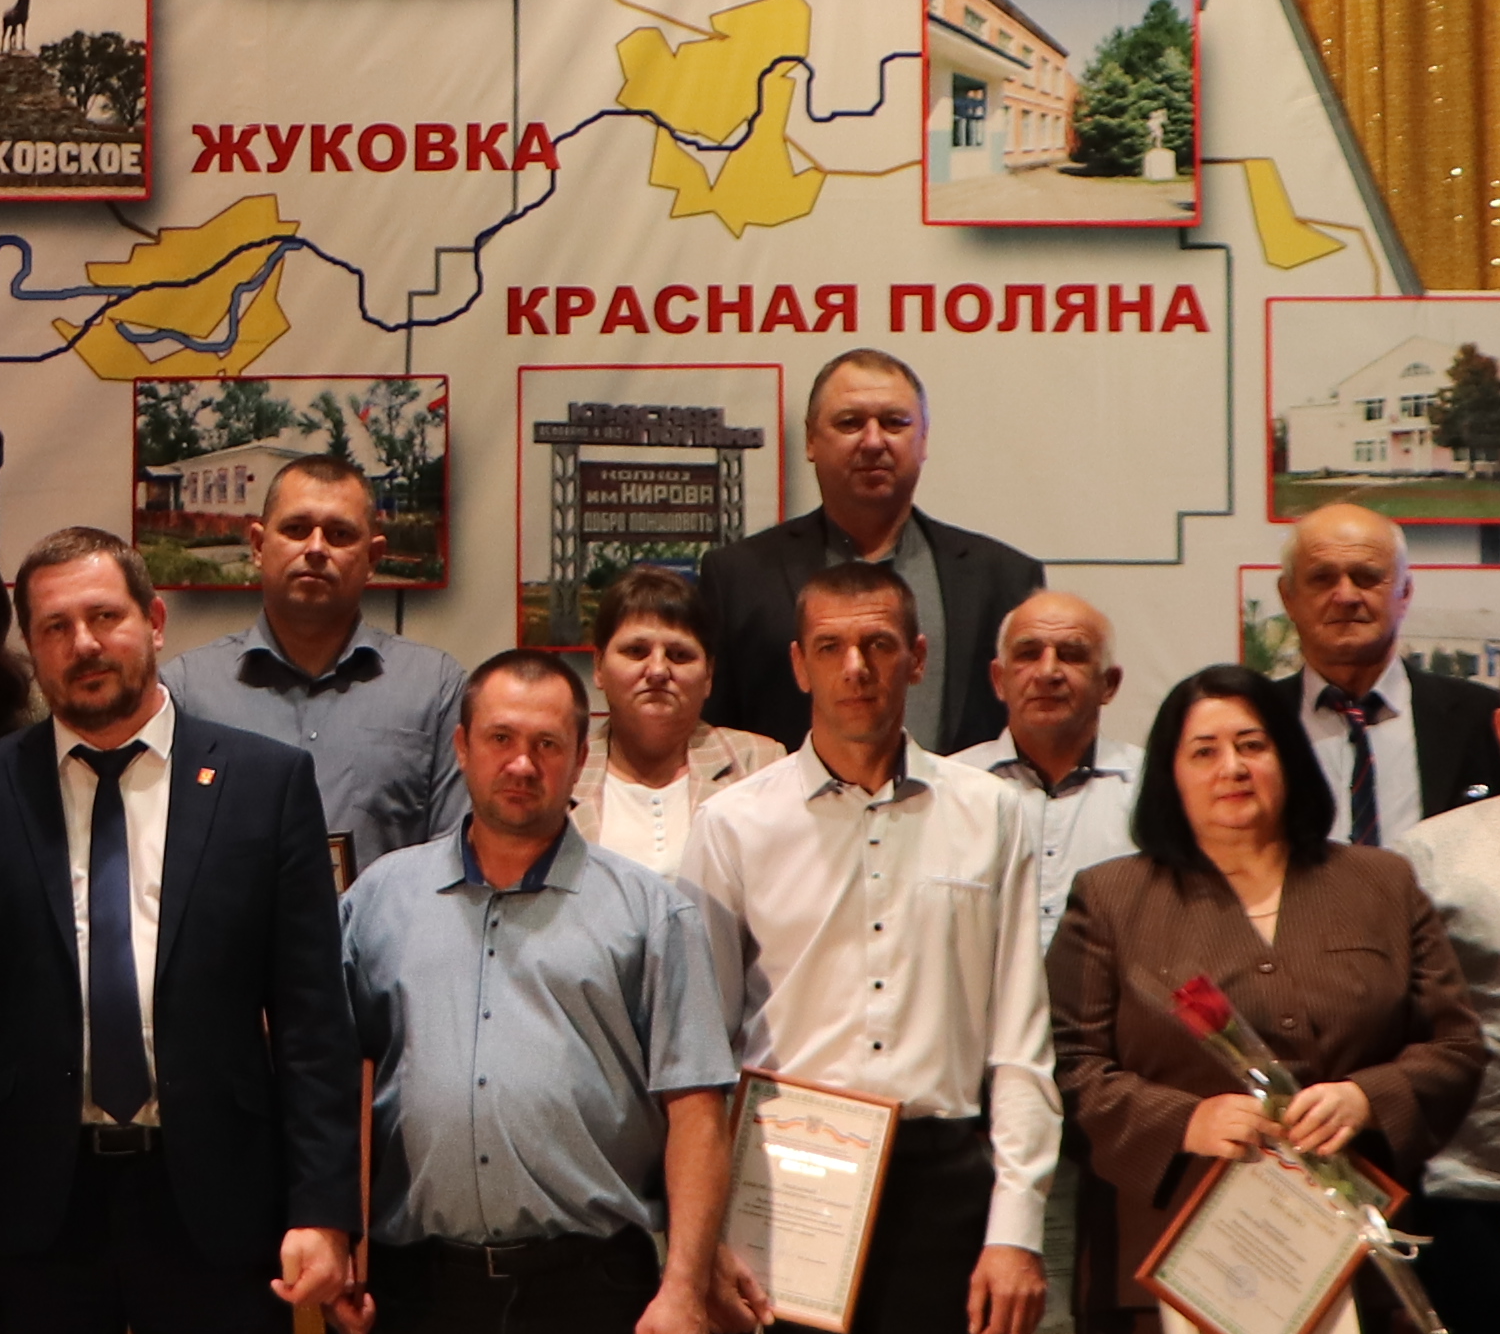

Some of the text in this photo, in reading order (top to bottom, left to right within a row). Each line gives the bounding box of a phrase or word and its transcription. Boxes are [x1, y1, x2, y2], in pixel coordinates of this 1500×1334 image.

[191, 121, 561, 175] ЖУКОВКА
[507, 282, 1210, 336] КРАСНАЯ ПОЛЯНА
